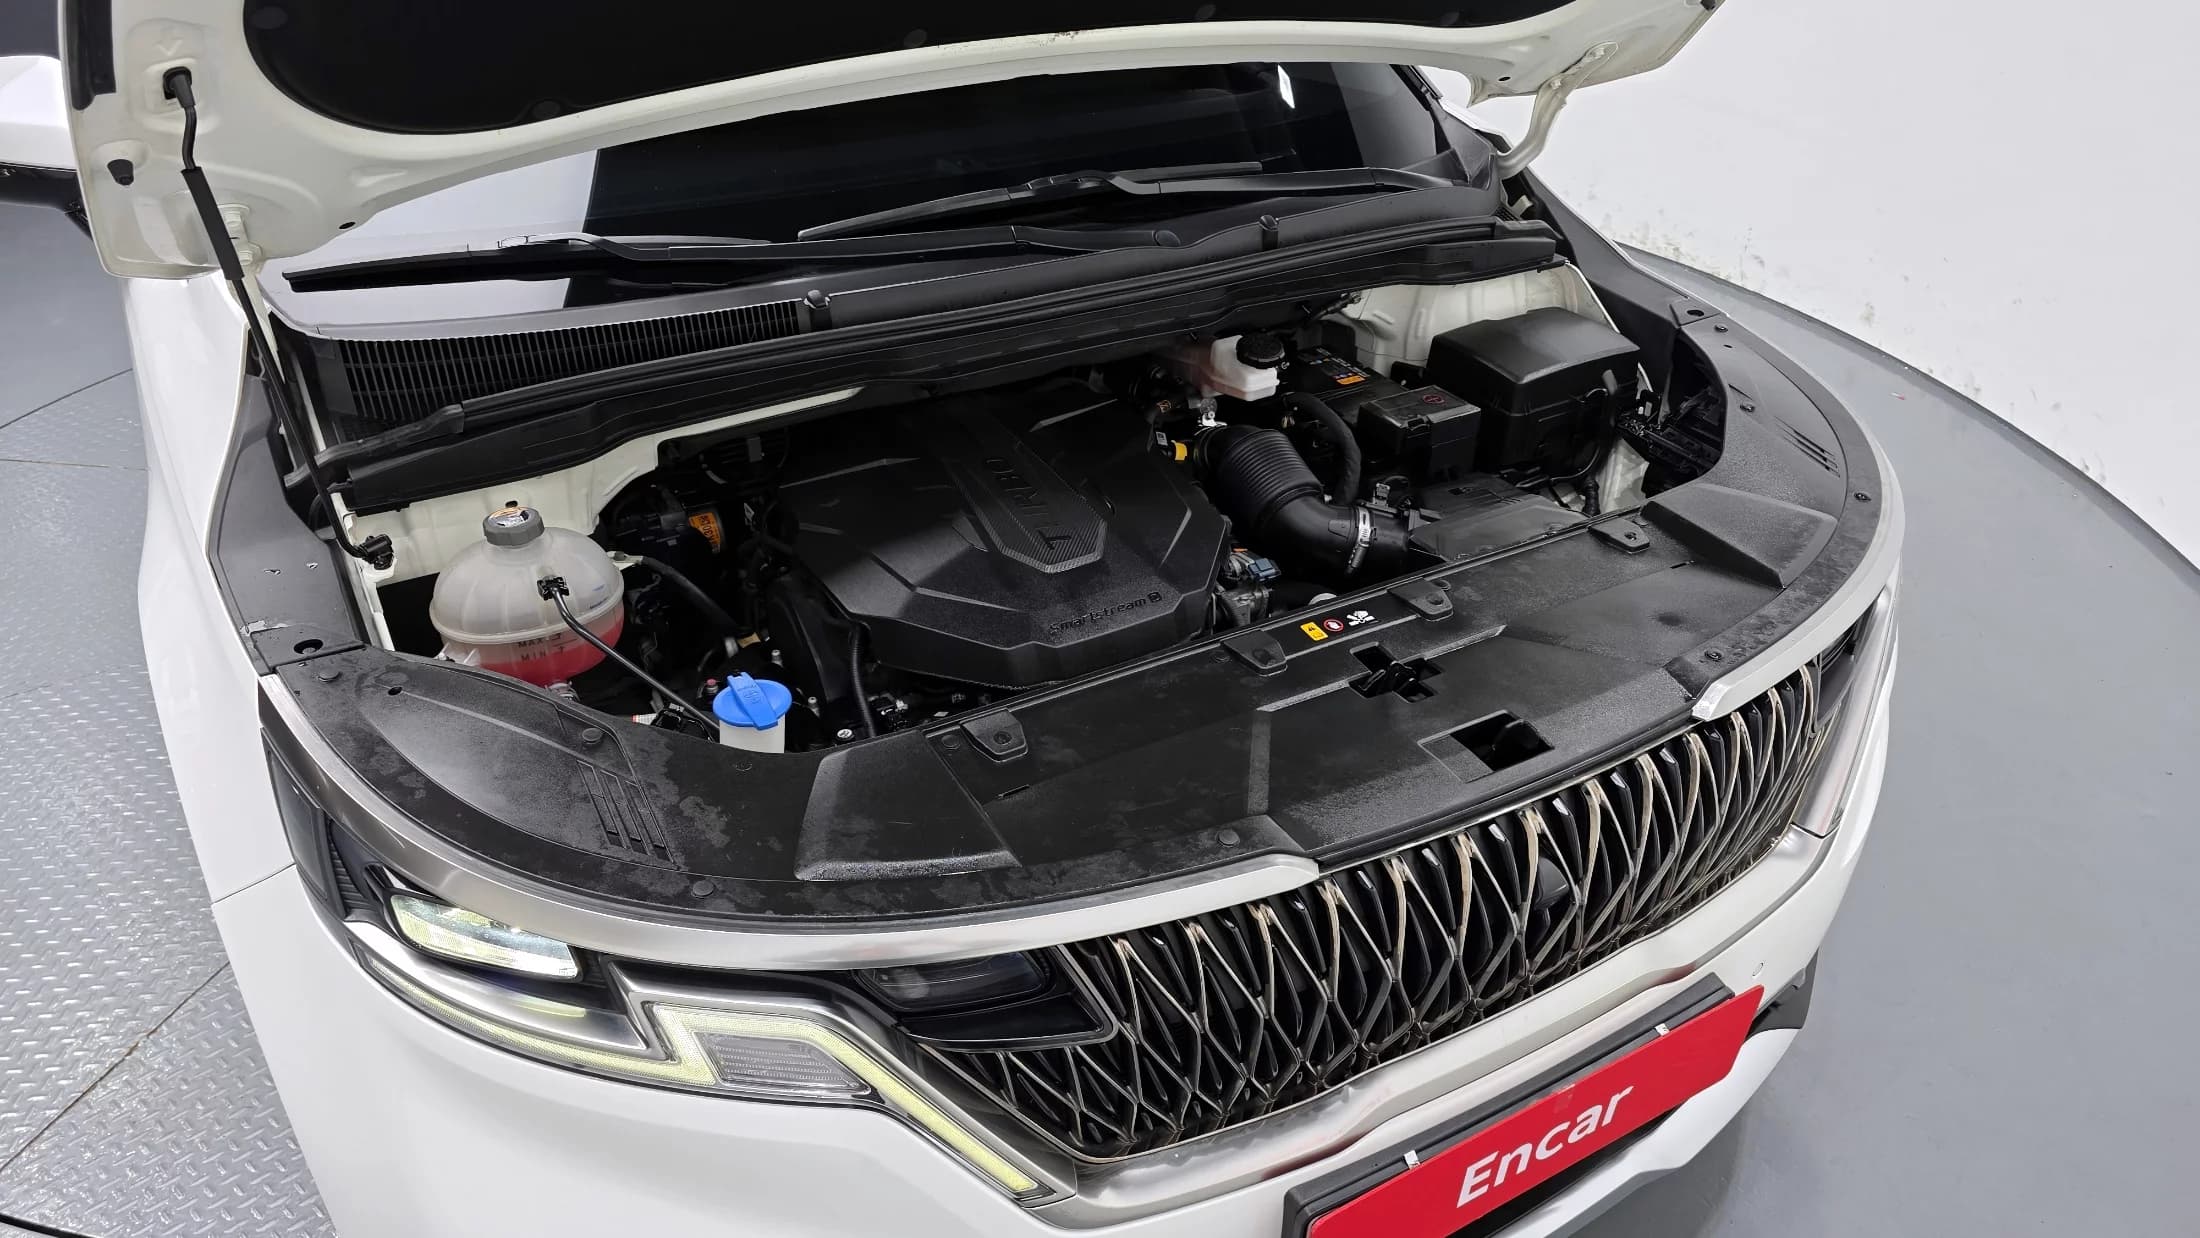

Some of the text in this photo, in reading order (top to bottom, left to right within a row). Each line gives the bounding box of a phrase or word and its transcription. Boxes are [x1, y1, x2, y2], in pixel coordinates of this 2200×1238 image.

[1049, 596, 1146, 634] Smartstream
[518, 637, 544, 648] MAX
[521, 650, 546, 662] MIN
[1456, 1085, 1635, 1209] Encar
